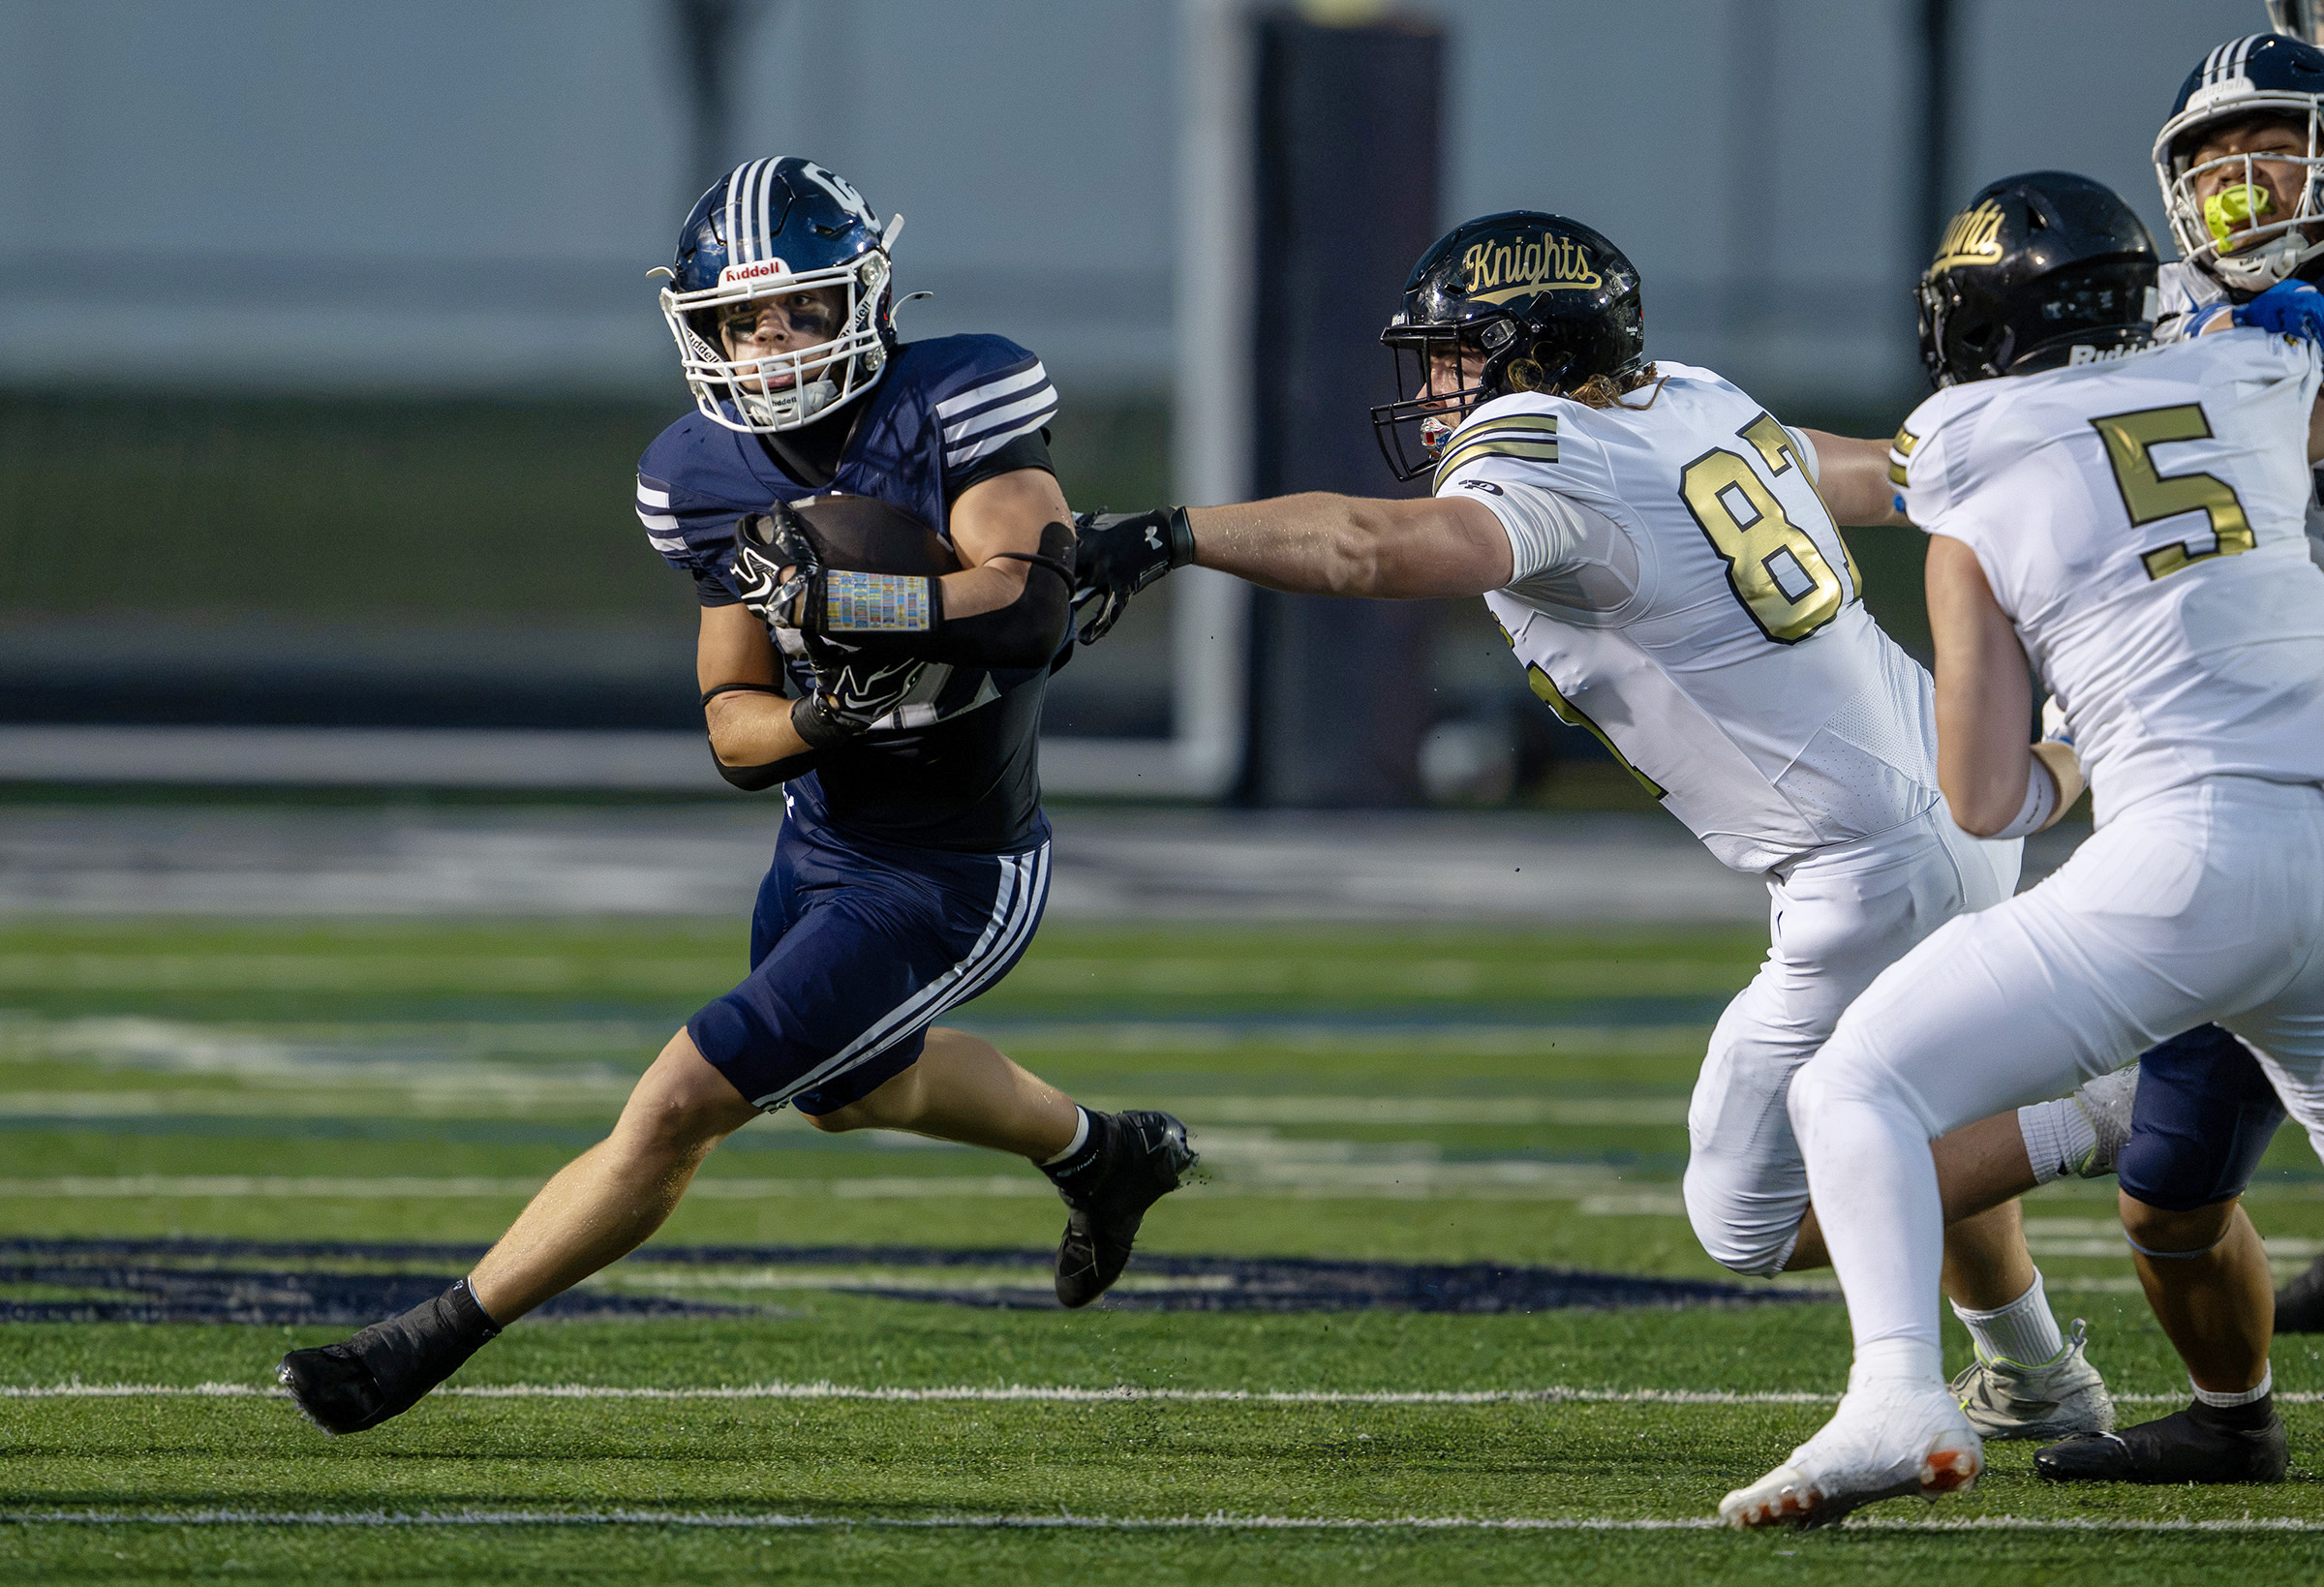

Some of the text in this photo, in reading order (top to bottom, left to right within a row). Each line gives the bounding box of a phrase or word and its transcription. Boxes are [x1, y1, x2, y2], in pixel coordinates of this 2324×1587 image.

[725, 260, 780, 282] Riddell
[1466, 231, 1603, 305] Knights
[1677, 410, 1863, 647] 87
[2088, 401, 2258, 582] 5
